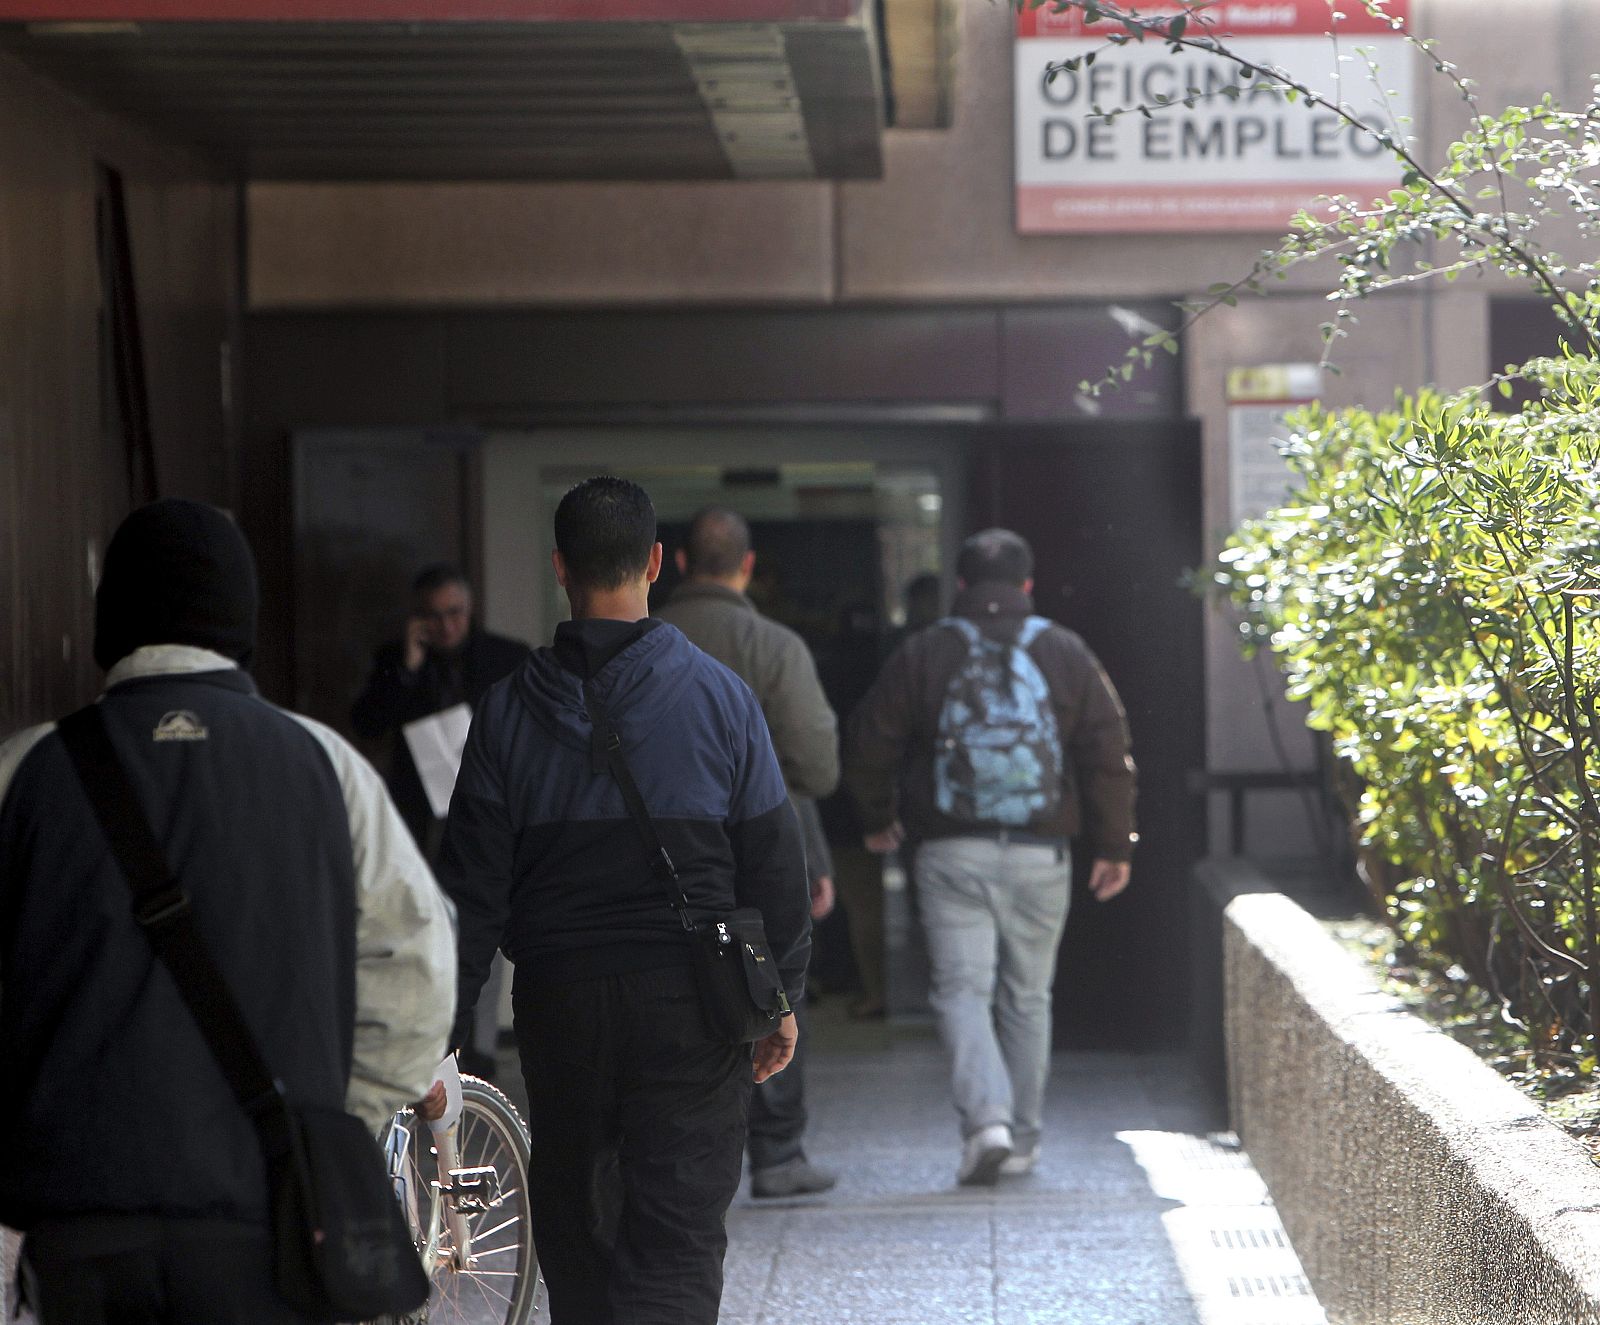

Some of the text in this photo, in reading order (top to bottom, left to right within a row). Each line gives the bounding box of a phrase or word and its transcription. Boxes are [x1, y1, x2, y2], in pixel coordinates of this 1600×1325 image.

[1040, 61, 1288, 107] OFICINA
[1040, 115, 1390, 161] DE EMPLEO
